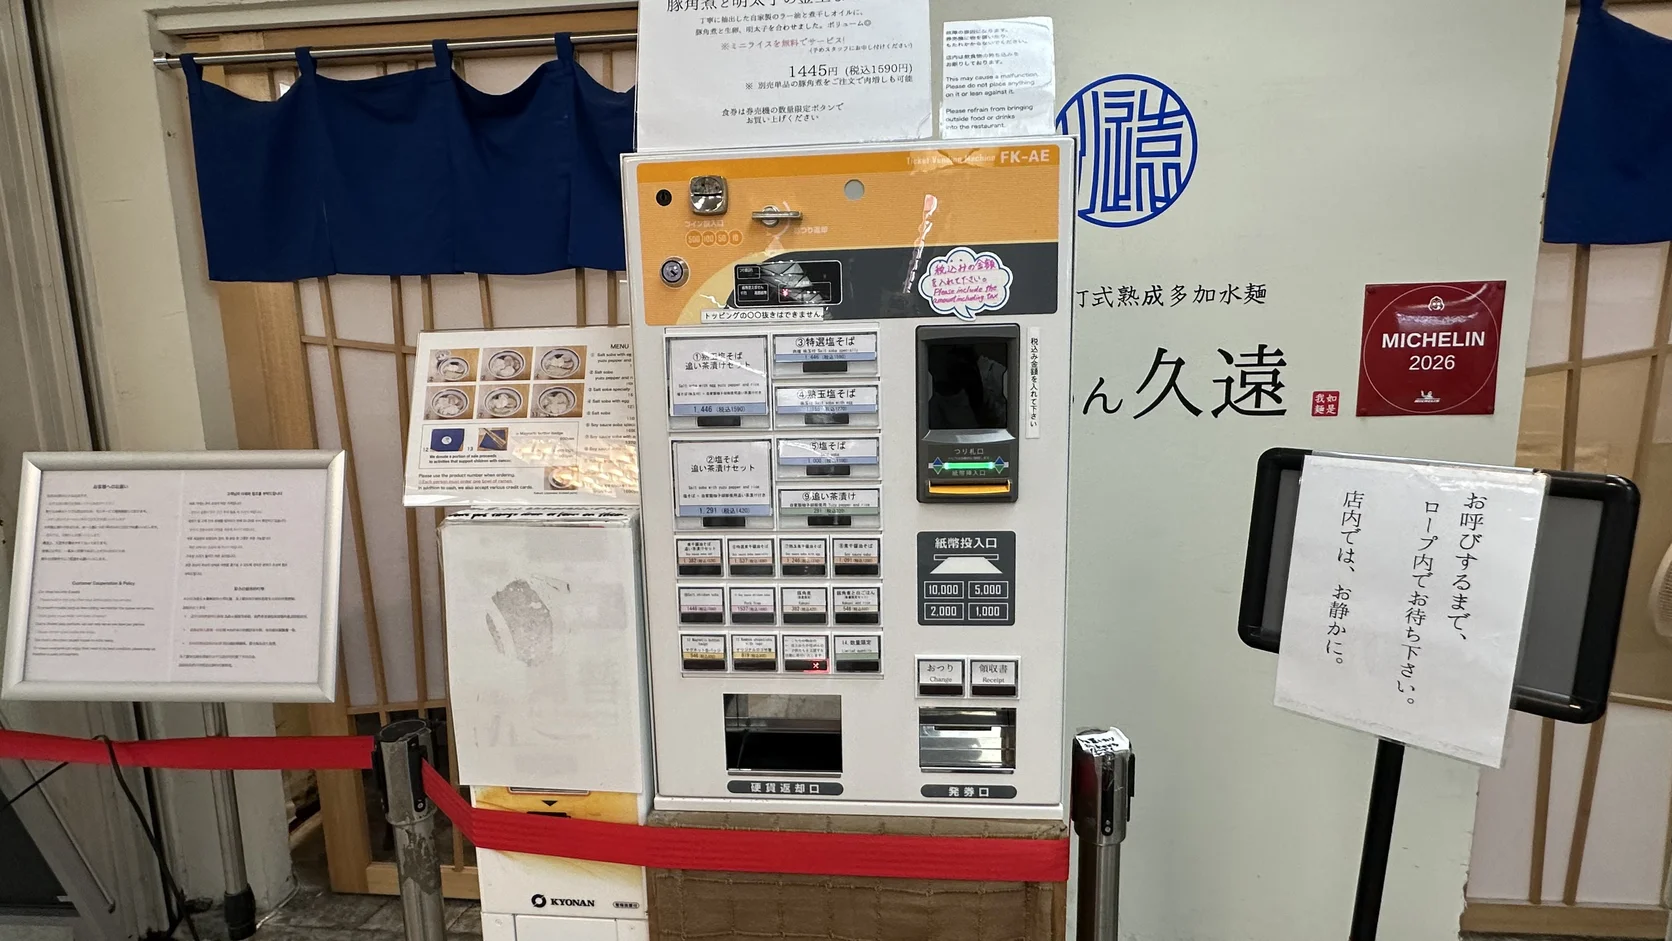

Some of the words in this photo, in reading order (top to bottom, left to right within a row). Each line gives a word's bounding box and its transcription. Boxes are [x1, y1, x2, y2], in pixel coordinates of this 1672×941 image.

[789, 65, 838, 78] 1445円
[746, 114, 820, 125] お買い上げください
[1000, 149, 1050, 164] FK-AE
[956, 285, 983, 293] include
[1381, 331, 1486, 349] MICHELIN
[685, 361, 750, 370] 追い茶漬けセト
[1408, 354, 1456, 371] 2026
[1030, 337, 1038, 427] 税込み金額を入れて下さい
[691, 464, 755, 472] 追い茶漬けセット
[935, 537, 997, 549] 紙幣投入口
[1447, 491, 1487, 641] お呼びするまで、
[929, 584, 958, 595] 10,000
[975, 584, 1001, 595] 5,000
[1395, 501, 1439, 705] ロープ内でお待ち下さい。
[930, 606, 957, 617] 2,000
[976, 606, 1000, 616] 1,000
[927, 664, 954, 672] おつり
[979, 664, 1008, 673] 領収書
[750, 782, 820, 793] 硬貨返却口
[948, 787, 989, 797] 発券口
[550, 898, 595, 907] KYONAN
